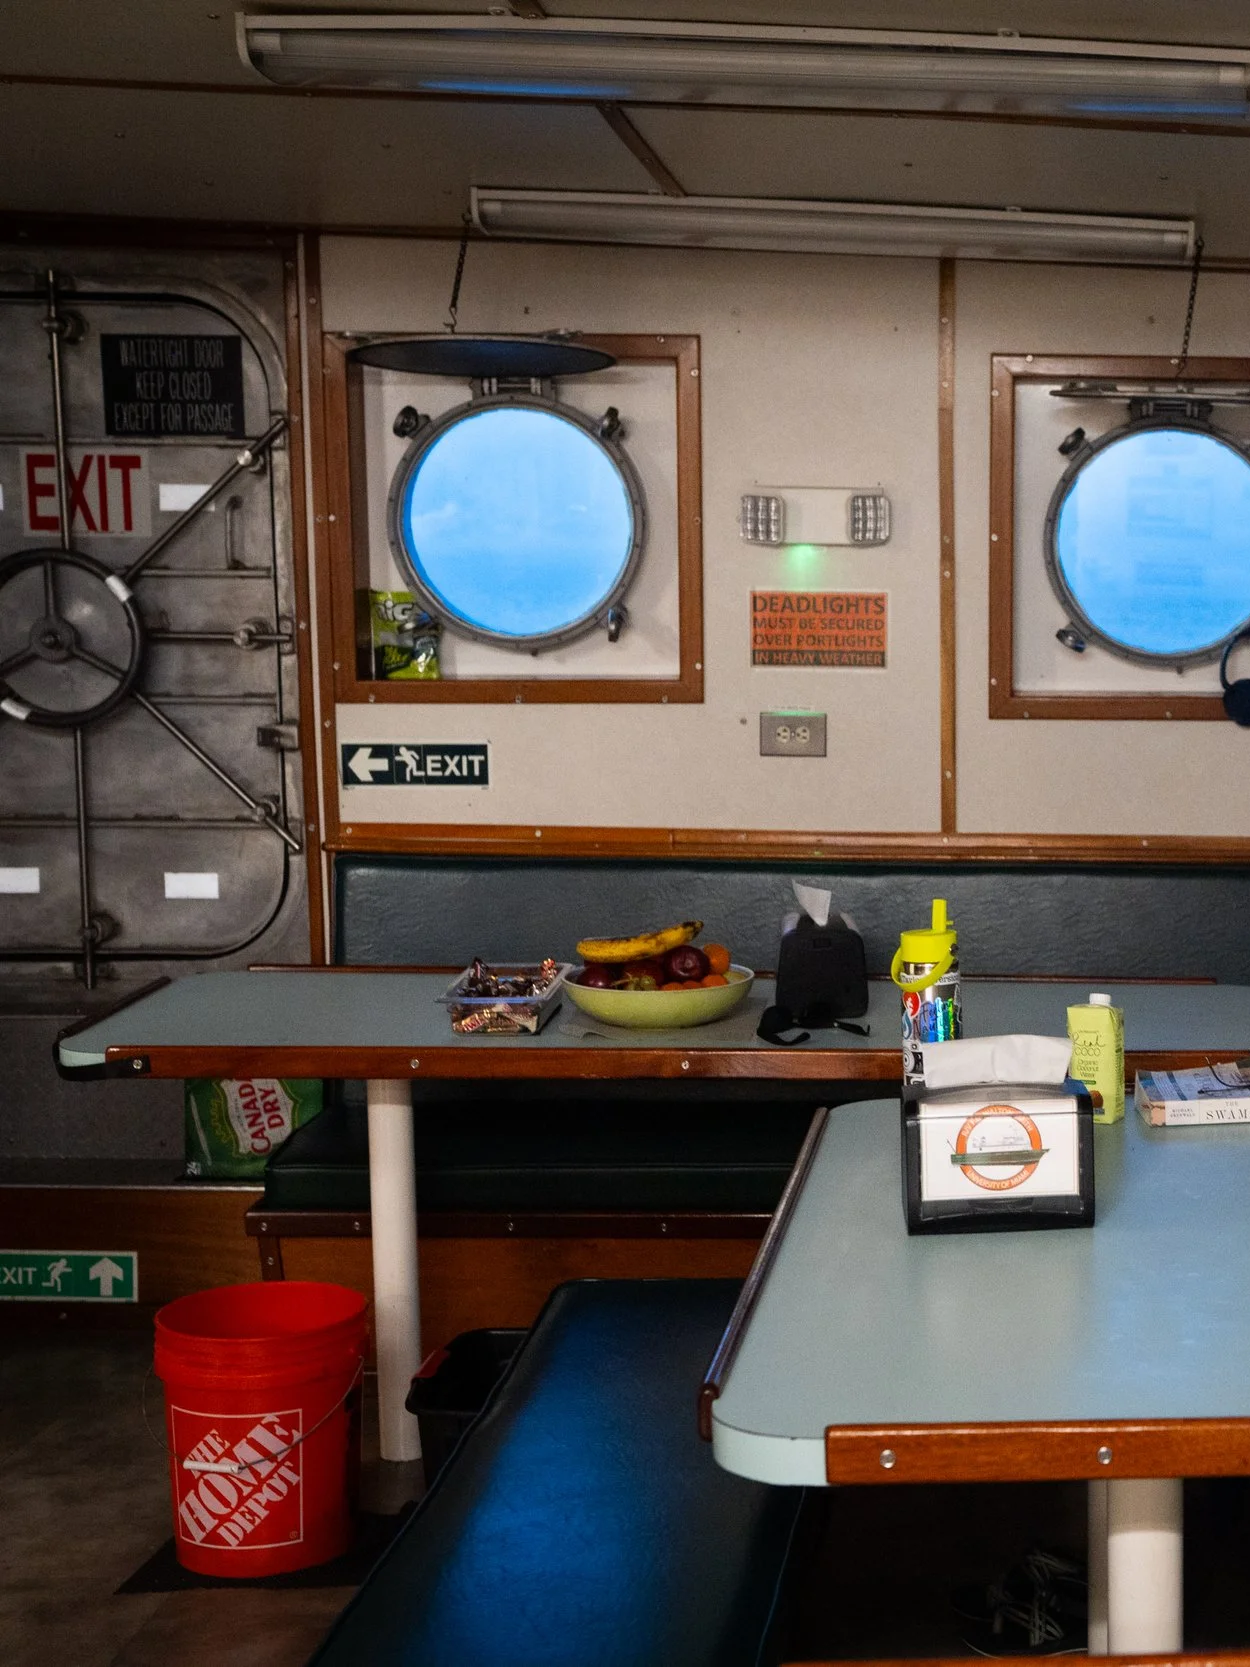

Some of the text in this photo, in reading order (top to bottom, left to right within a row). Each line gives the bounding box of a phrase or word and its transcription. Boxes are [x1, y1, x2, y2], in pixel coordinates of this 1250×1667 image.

[119, 339, 224, 368] WATERTIGHT DOOR
[136, 371, 212, 400] KEEP CLOSED
[115, 402, 234, 432] EXCEPT FOR PASSAGE
[26, 454, 141, 532] EXIT
[753, 595, 885, 615] DEADLIGHTS
[753, 616, 884, 631] MUST BE SECURED
[754, 634, 883, 648] OVER PORTLIGHTS
[755, 652, 882, 666] IN HEAVY WEATHER
[426, 755, 485, 776] EXIT
[239, 1078, 271, 1154] CANAD
[258, 1087, 284, 1129] DRY
[0, 1267, 37, 1285] XIT
[183, 1428, 231, 1480] THE
[180, 1414, 301, 1543] HOME
[216, 1461, 300, 1546] DEPOT
